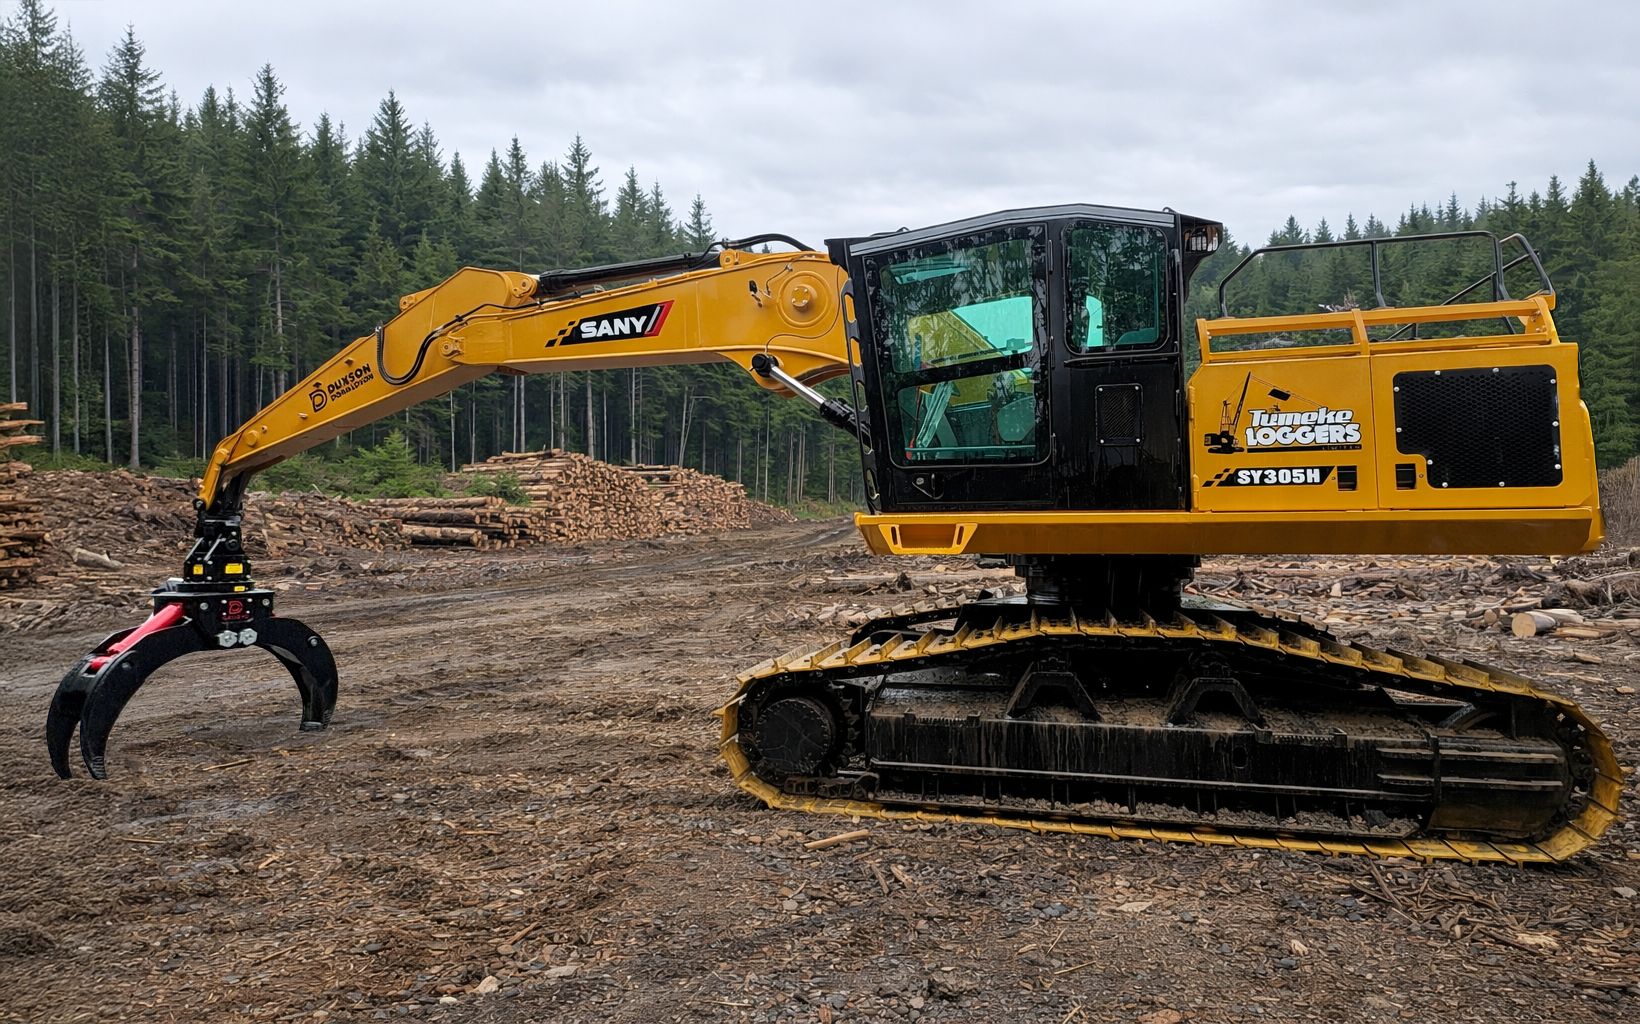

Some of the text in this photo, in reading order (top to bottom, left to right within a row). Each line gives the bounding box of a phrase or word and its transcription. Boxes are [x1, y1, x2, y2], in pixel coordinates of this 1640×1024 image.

[580, 316, 648, 339] SANY
[1247, 406, 1353, 427] Tumeke
[1245, 423, 1362, 446] LOGGERS
[1237, 468, 1321, 485] SY305H
